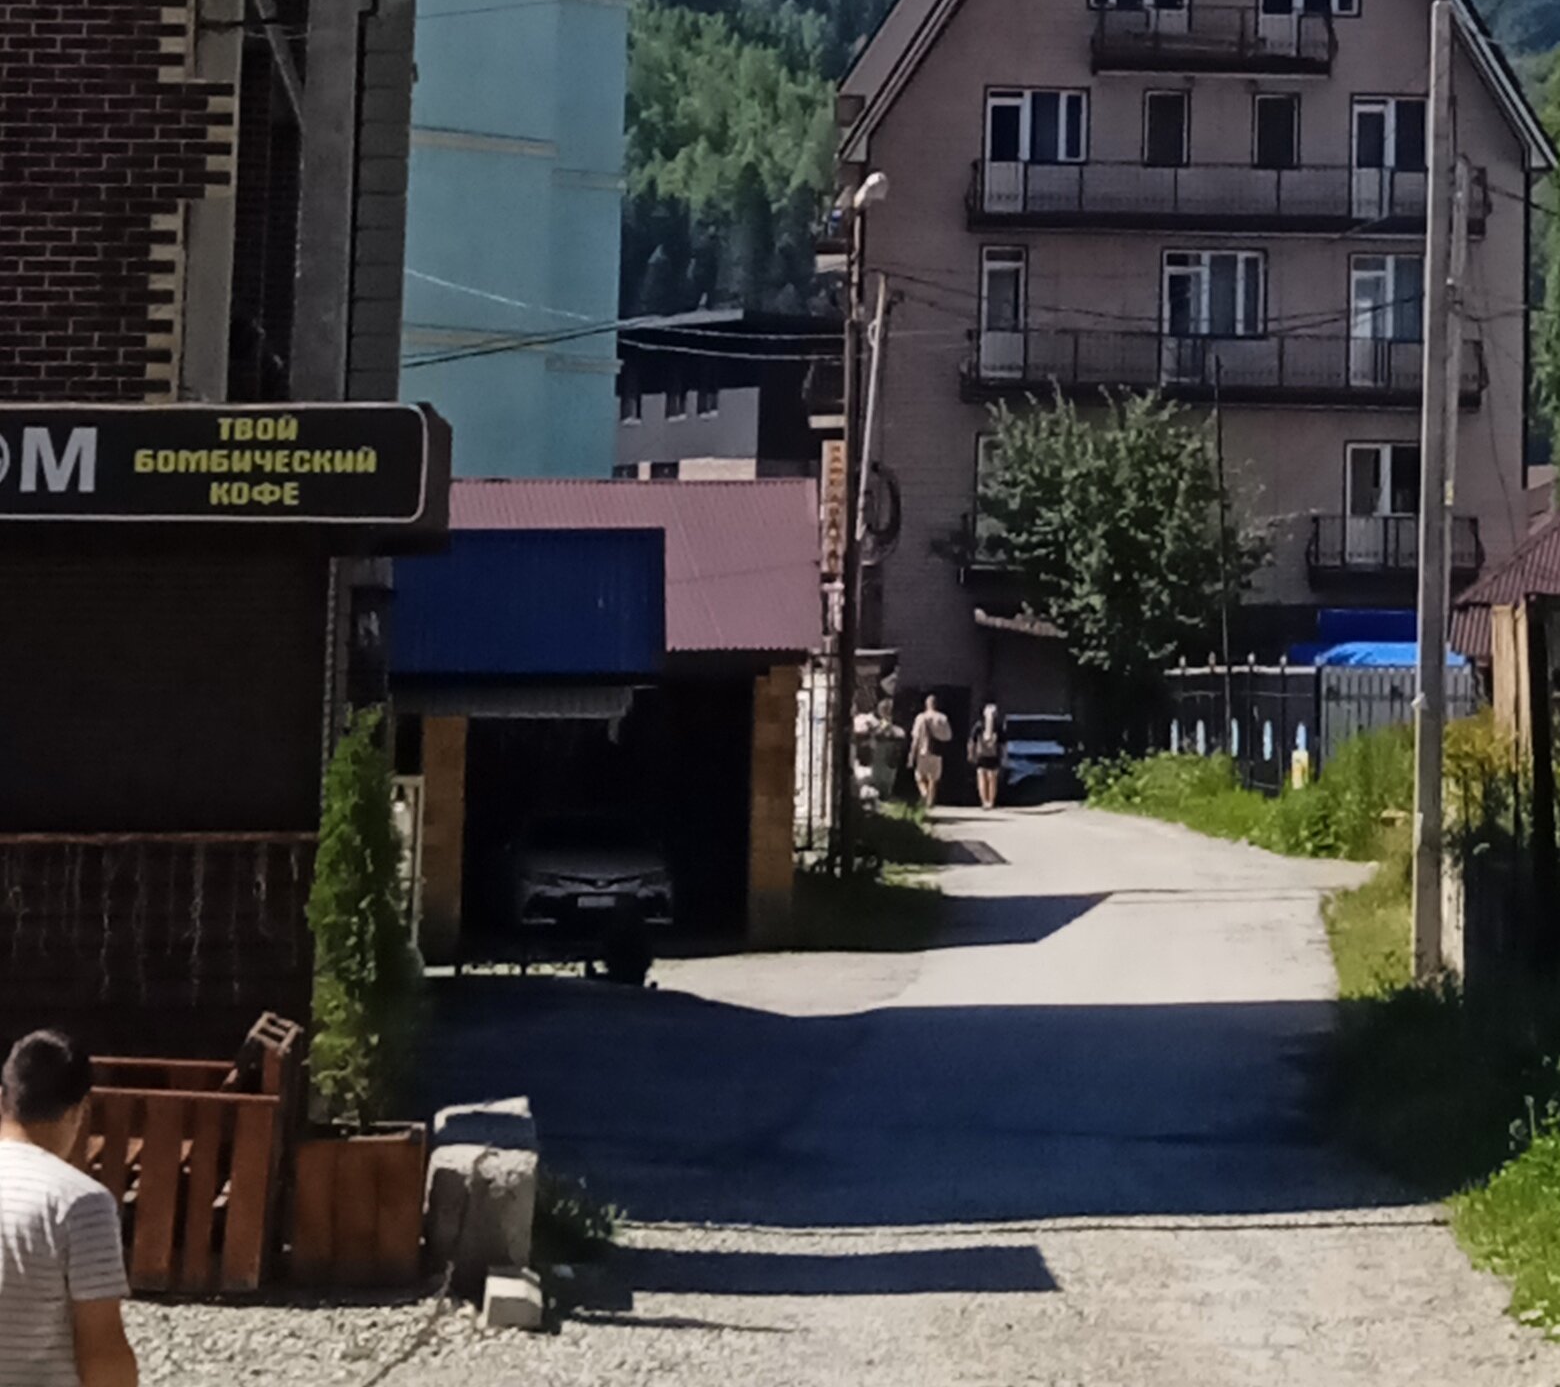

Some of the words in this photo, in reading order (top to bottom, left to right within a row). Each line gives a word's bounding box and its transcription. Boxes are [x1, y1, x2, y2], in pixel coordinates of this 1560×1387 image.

[217, 414, 299, 441] ТВОЙ
[0, 426, 98, 493] M
[134, 447, 377, 473] БОМБИЧЕСКИЙ
[209, 481, 300, 506] КОФЕ
